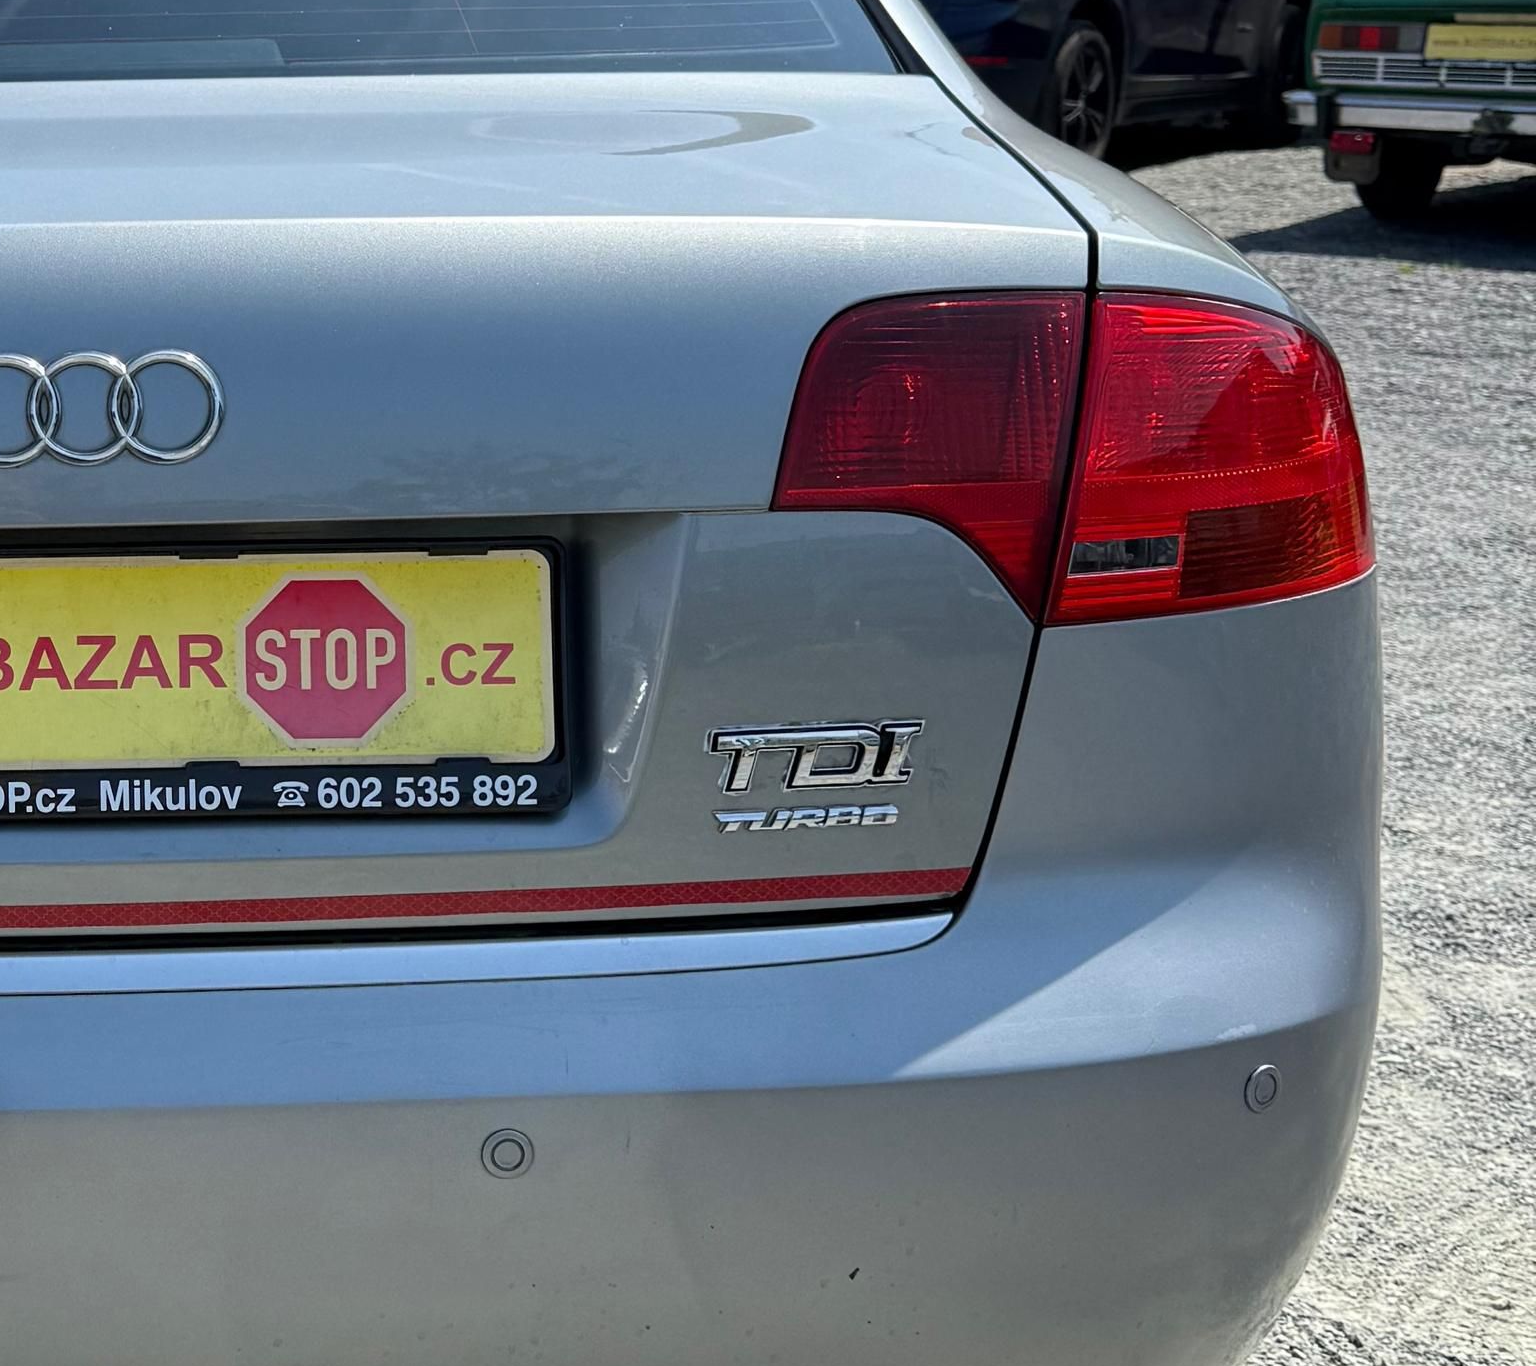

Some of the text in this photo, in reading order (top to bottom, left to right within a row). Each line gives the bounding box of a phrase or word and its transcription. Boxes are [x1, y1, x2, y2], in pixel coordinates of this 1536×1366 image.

[254, 627, 397, 691] STOP
[703, 718, 926, 795] TDI
[99, 777, 243, 813] Mikulov
[316, 776, 383, 809] 602
[394, 775, 461, 807] 535
[471, 773, 538, 807] 892
[711, 802, 900, 834] TURBO
